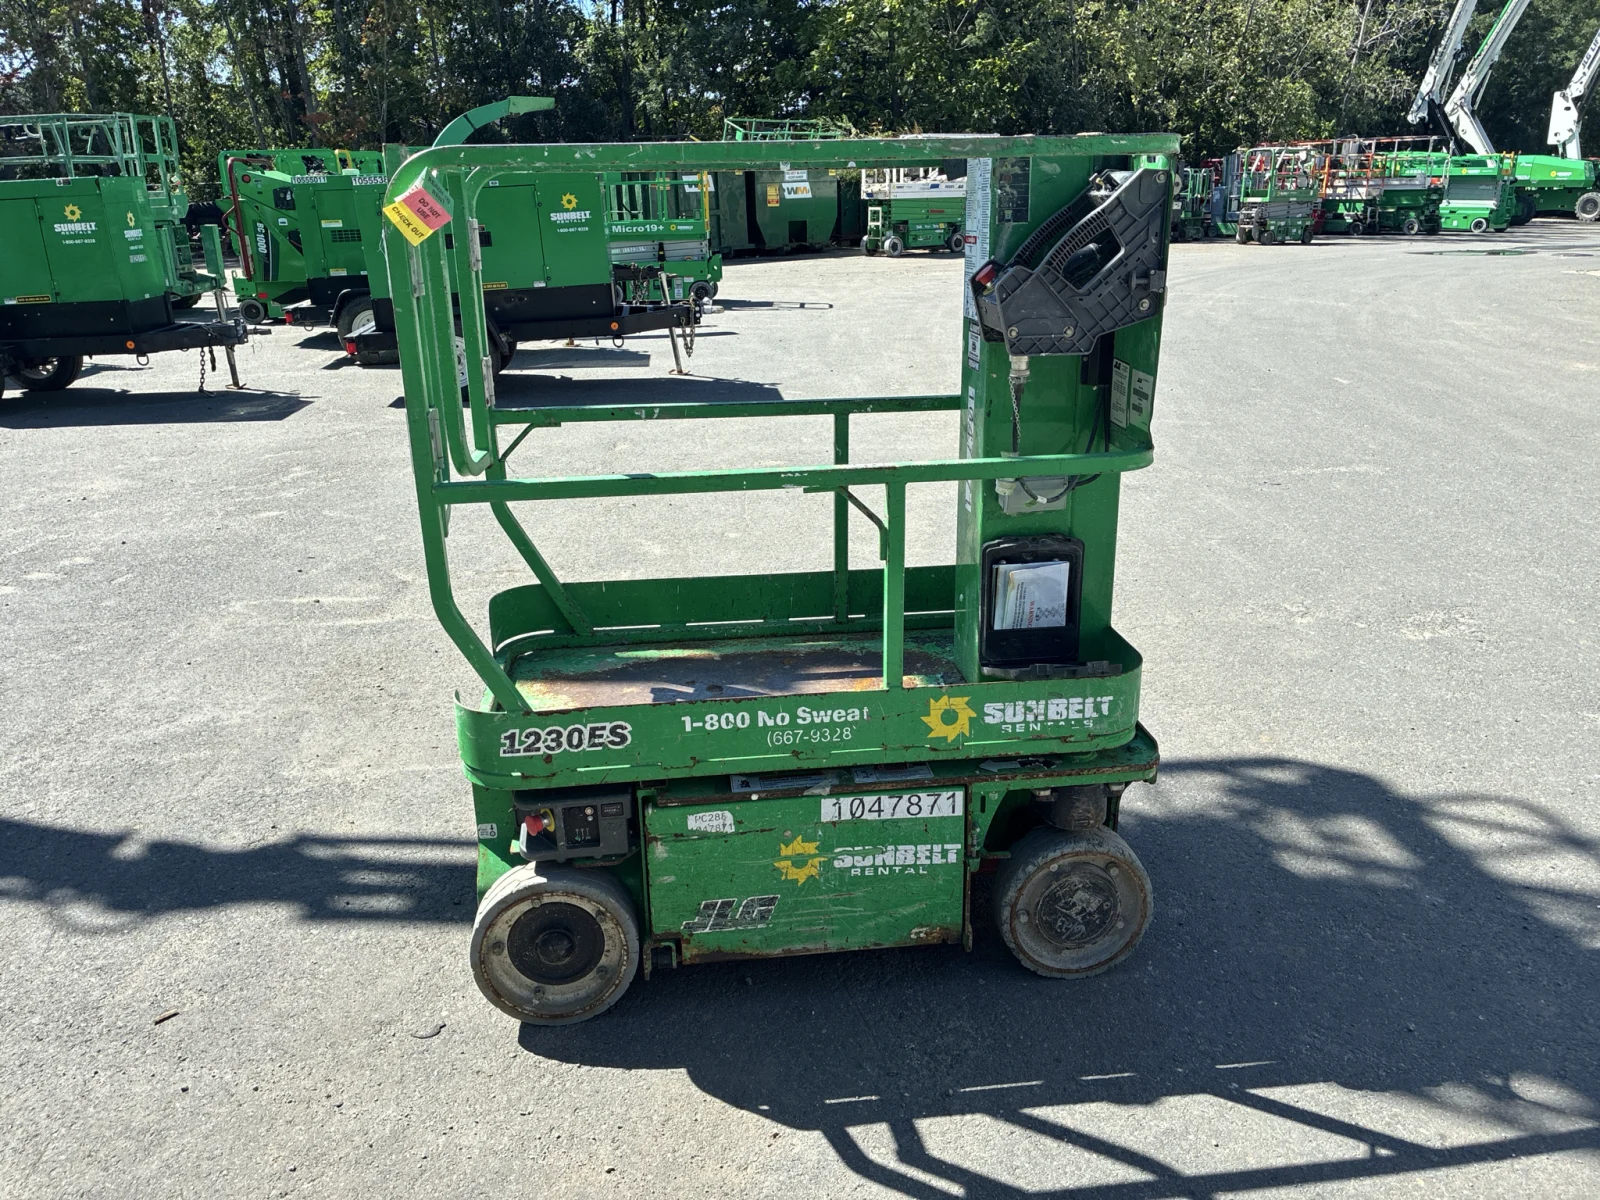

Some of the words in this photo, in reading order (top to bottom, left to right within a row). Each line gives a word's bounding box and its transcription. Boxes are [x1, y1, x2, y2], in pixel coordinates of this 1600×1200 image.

[293, 176, 326, 184] 10555011
[786, 186, 808, 195] WM
[416, 207, 430, 219] USE
[418, 197, 429, 207] DO
[428, 207, 441, 219] NOT
[550, 211, 591, 221] SUNBELT
[54, 222, 96, 232] SUNBELT
[392, 206, 413, 228] CHECK
[411, 226, 424, 238] OUT
[612, 224, 664, 232] Micro19+
[681, 712, 750, 732] 1-800
[758, 710, 790, 728] No
[796, 706, 869, 725] Sweat
[984, 696, 1113, 724] SUNBELT
[500, 721, 632, 757] 1230ES
[832, 792, 957, 820] 1047871
[833, 844, 961, 868] SUNBELT
[681, 895, 780, 933] JLG
